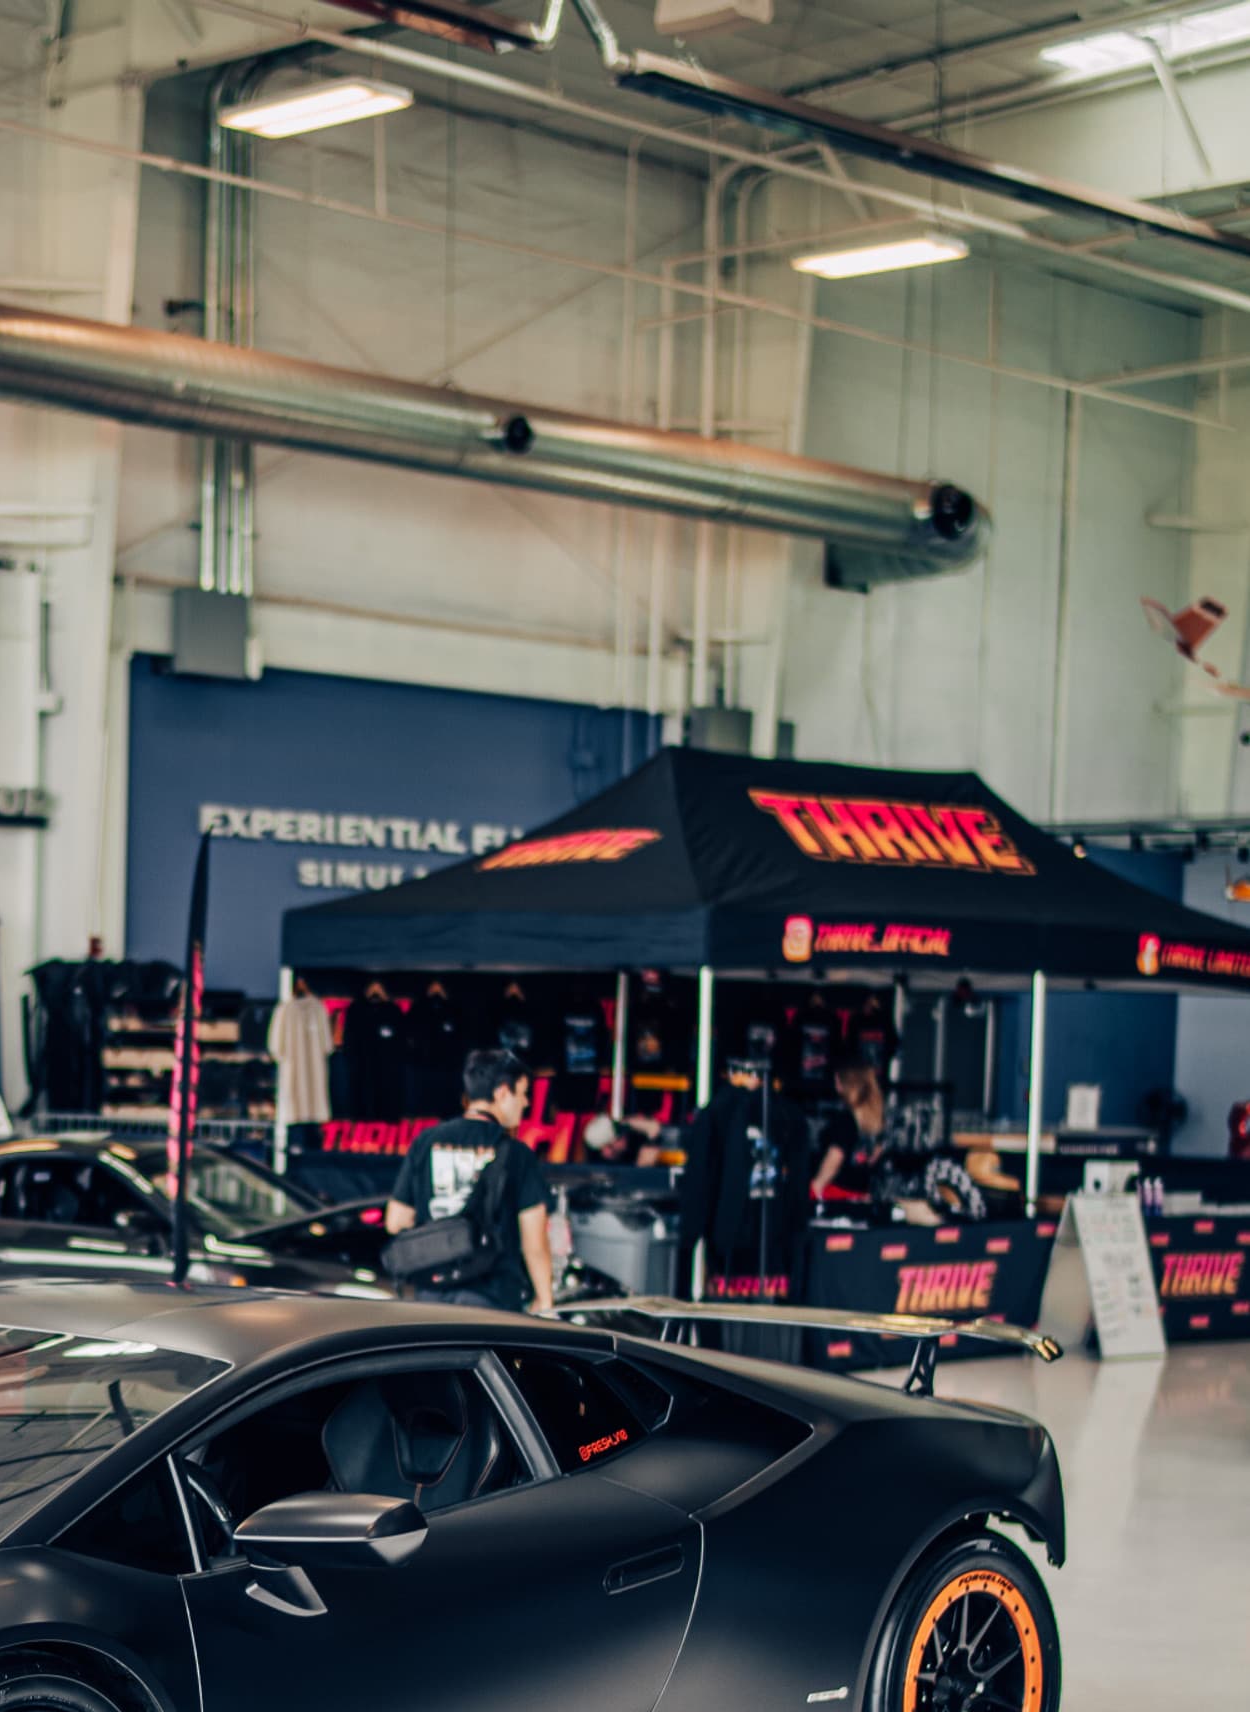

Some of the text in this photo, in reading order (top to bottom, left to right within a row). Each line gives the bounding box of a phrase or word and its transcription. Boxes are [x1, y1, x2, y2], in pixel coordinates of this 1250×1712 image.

[199, 805, 465, 854] EXPERIENTIAL
[749, 790, 1037, 875] THRIVE
[895, 1261, 997, 1314] THRIVE
[1159, 1252, 1244, 1296] THRIVE
[958, 1573, 1014, 1592] FORGELINE
